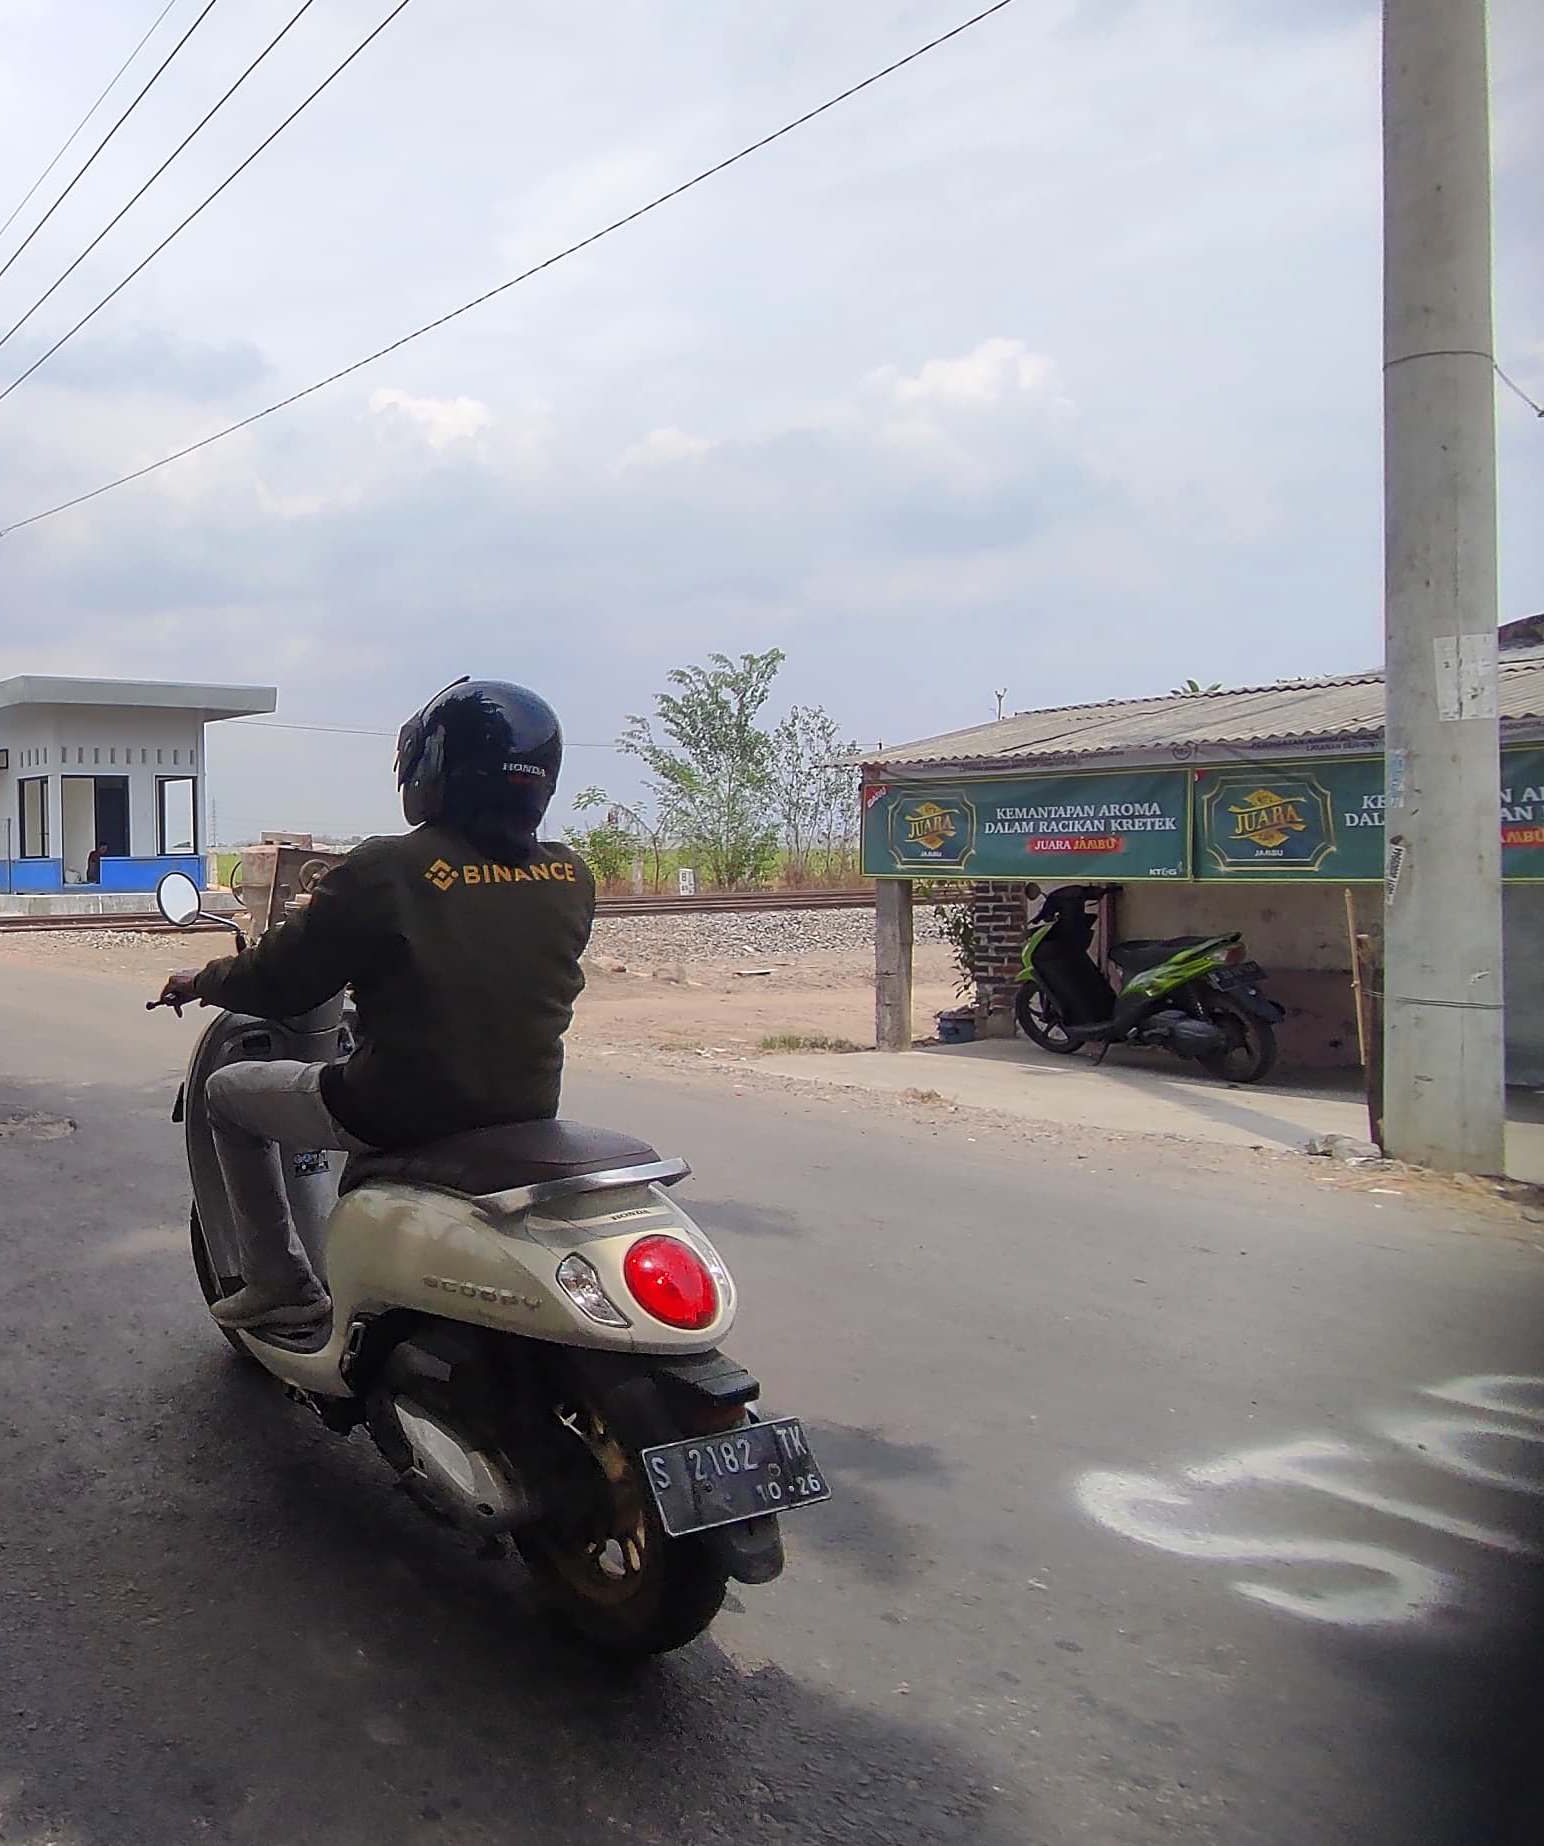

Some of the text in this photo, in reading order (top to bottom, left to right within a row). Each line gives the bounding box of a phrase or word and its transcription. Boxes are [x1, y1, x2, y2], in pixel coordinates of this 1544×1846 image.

[503, 762, 546, 777] HONDA
[996, 802, 1162, 819] KEMANTAPAN AROMA
[1234, 804, 1305, 834] JUARA
[908, 815, 956, 839] JUARA
[984, 817, 1177, 834] DALAM RACIKAN KRETEK
[1034, 834, 1117, 851] JUARA JAMBU
[463, 862, 577, 884] BINANCE
[650, 1424, 807, 1489] S 2182 TK
